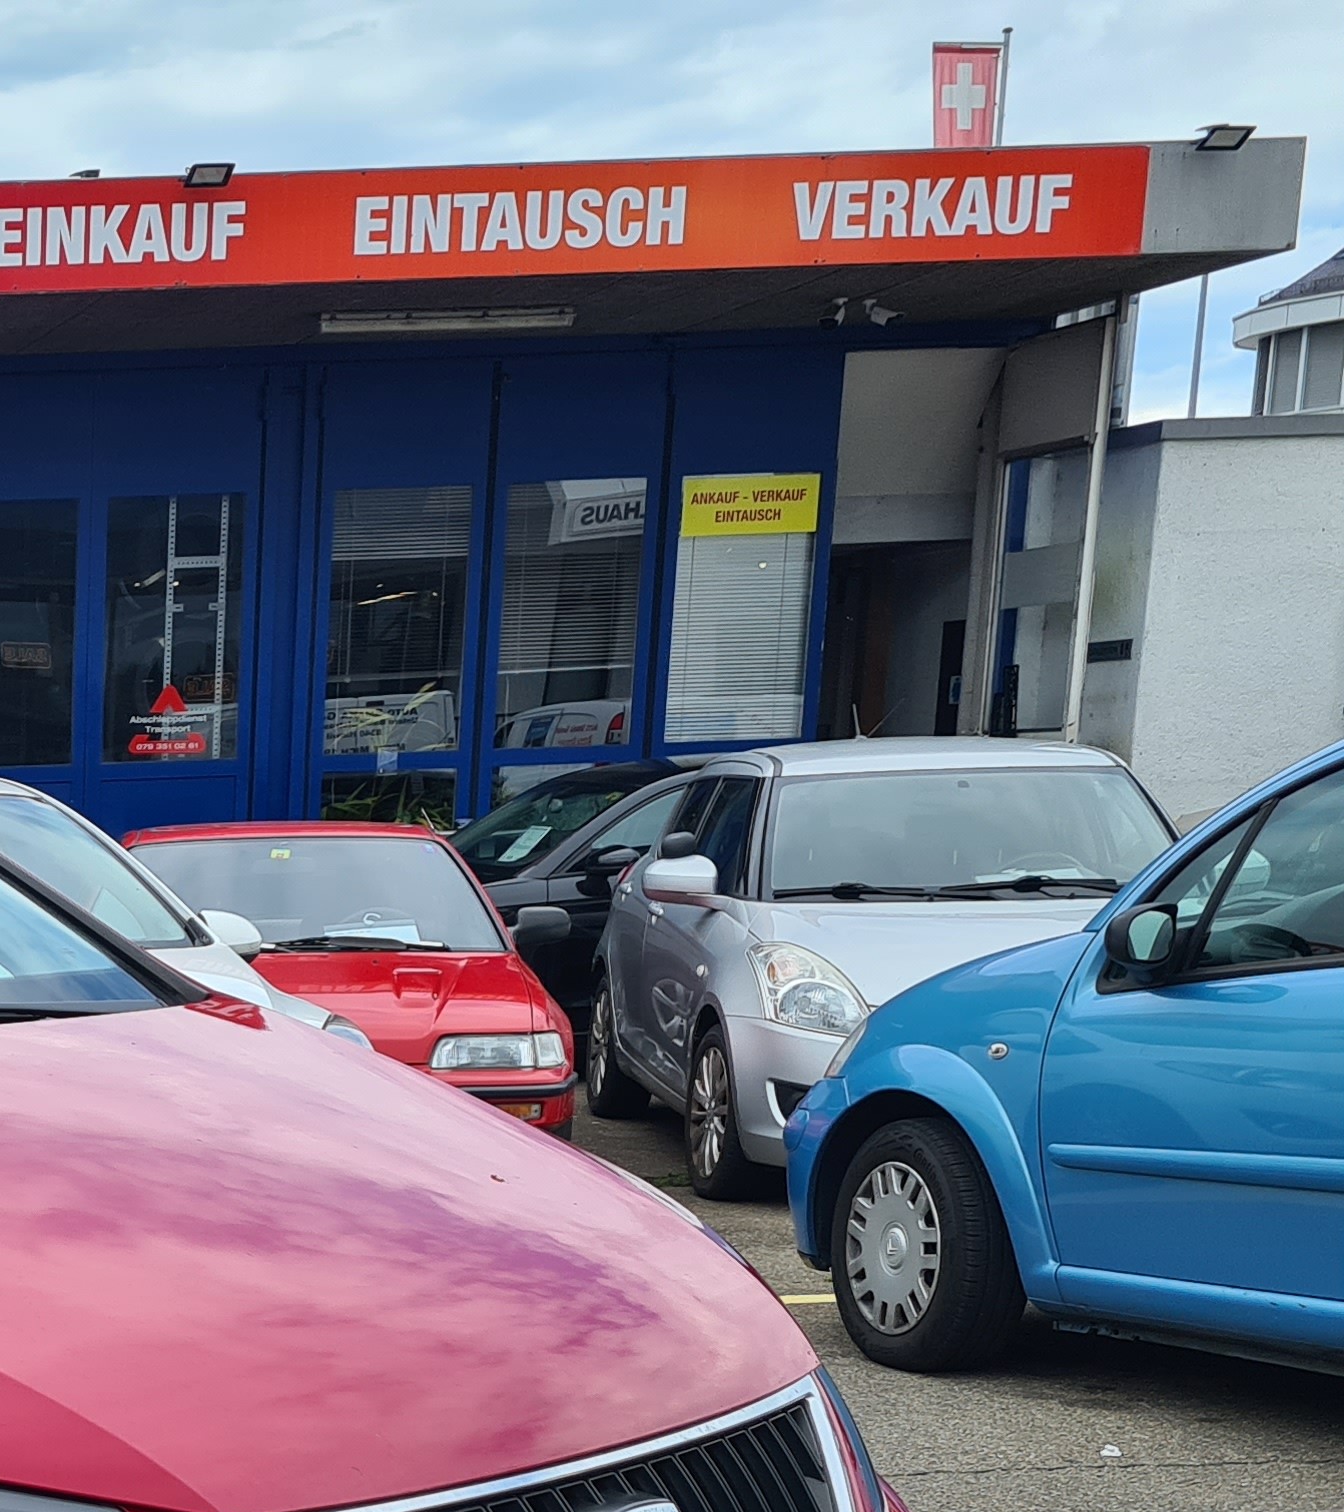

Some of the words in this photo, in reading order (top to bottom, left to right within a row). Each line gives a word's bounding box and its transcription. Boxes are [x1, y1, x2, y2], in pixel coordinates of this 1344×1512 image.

[353, 186, 687, 255] EINTAUSCH
[793, 173, 1073, 241] VERKAUF
[691, 491, 740, 505] ANKAUF
[752, 488, 807, 503] VERKAUF
[714, 508, 781, 523] EINTAUSCH
[129, 714, 207, 724] Abschleppdienst
[145, 725, 191, 734] Transport
